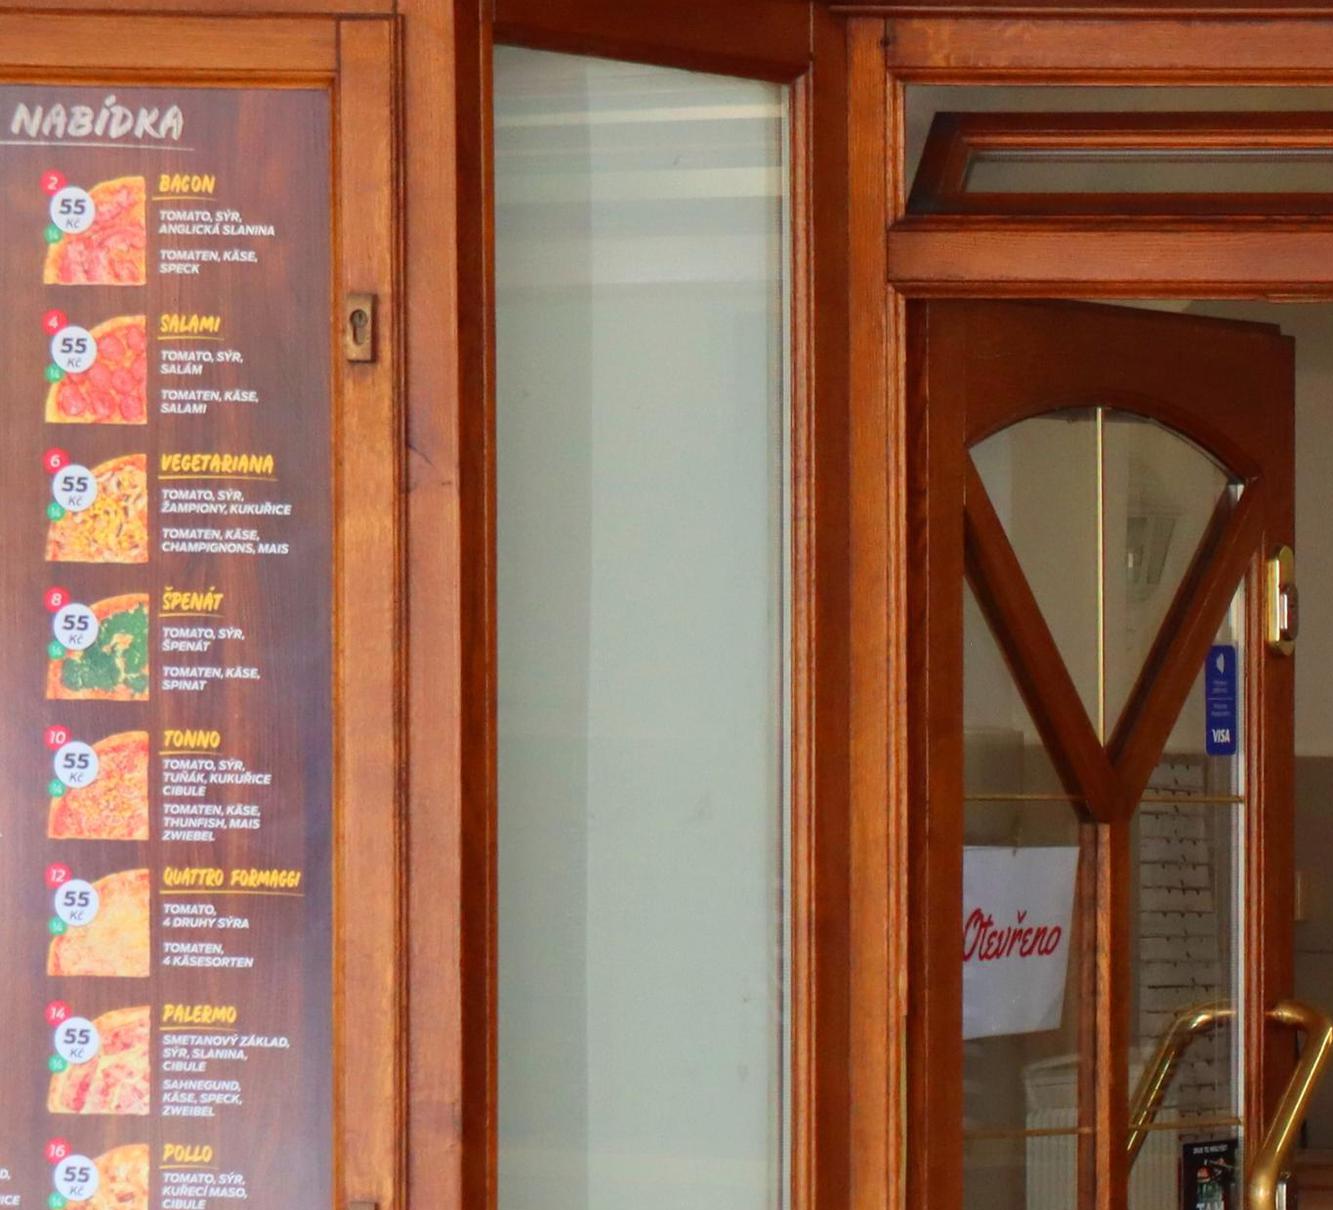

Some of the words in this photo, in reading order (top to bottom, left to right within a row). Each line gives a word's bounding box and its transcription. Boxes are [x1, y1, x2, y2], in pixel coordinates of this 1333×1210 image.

[11, 95, 183, 140] NABÍDKA
[159, 174, 215, 193] BACON
[59, 198, 86, 215] 55
[159, 210, 213, 223] TOMATO,
[215, 208, 242, 223] SÝR,
[159, 222, 220, 235] ANGLICKÁ
[223, 224, 275, 236] SLANINA
[160, 250, 221, 262] TOMATEN,
[224, 249, 258, 263] KÄSE,
[159, 263, 200, 274] SPECK
[160, 315, 220, 333] SALAMI
[60, 338, 88, 353] 55
[161, 351, 213, 363] TOMATO,
[217, 348, 243, 363] SÝR,
[160, 362, 203, 375] SALÁM
[161, 390, 221, 403] TOMATEN,
[225, 389, 258, 403] KÄSE,
[161, 403, 207, 414] SALAMI
[161, 453, 274, 474] VEGETARIANA
[61, 476, 88, 492] 55
[162, 490, 215, 502] TOMATO,
[217, 488, 244, 502] SÝR,
[161, 501, 228, 515] ŽAMPIONY,
[230, 502, 292, 516] KUKUŘICE
[162, 529, 222, 541] TOMATEN,
[225, 528, 259, 541] KÄSE,
[162, 542, 256, 555] CHAMPIGNONS,
[258, 543, 289, 554] MAIS
[162, 586, 224, 611] ŠPENÁT
[62, 615, 89, 631] 55
[163, 628, 215, 640] TOMATO,
[218, 626, 244, 640] SÝR,
[162, 639, 210, 652] ŠPENÁT
[163, 667, 223, 680] TOMATEN,
[226, 666, 260, 680] KÄSE,
[162, 680, 207, 691] SPINAT
[163, 730, 220, 749] TONNO
[1212, 728, 1231, 743] VISA
[63, 753, 90, 769] 55
[163, 760, 216, 772] TOMATO,
[219, 759, 245, 772] SÝR,
[163, 771, 207, 785] TUŇÁK,
[210, 772, 272, 784] KUKUŘICE
[162, 786, 206, 797] CIBULE
[163, 804, 223, 816] TOMATEN,
[226, 803, 261, 816] KÄSE,
[163, 818, 227, 830] THUNFISH,
[229, 818, 260, 829] MAIS
[162, 831, 215, 841] ZWIEBEL
[163, 867, 225, 888] QUATTRO
[231, 868, 301, 888] FORMAGGI
[63, 891, 90, 907] 55
[164, 905, 216, 916] TOMATO,
[163, 918, 171, 928] 4
[173, 918, 216, 928] DRUHY
[217, 915, 249, 929] SÝRA
[963, 908, 1062, 961] Otevřeno
[164, 943, 224, 956] TOMATEN,
[163, 957, 171, 967] 4
[173, 955, 253, 967] KÄSESORTEN
[163, 1005, 236, 1024] PALERMO
[63, 1029, 90, 1045] 55
[163, 1033, 239, 1046] SMETANOVÝ
[240, 1034, 290, 1048] ZÁKLAD,
[163, 1047, 189, 1060] SÝR,
[192, 1049, 248, 1061] SLANINA,
[162, 1061, 206, 1072] CIBULE
[162, 1080, 241, 1092] SAHNEGUND,
[163, 1092, 198, 1105] KÄSE,
[200, 1093, 243, 1106] SPECK,
[162, 1106, 215, 1116] ZWEIBEL
[163, 1144, 212, 1162] POLLO
[63, 1166, 90, 1183] 55
[163, 1173, 216, 1185] TOMATO,
[219, 1171, 245, 1185] SÝR,
[162, 1184, 207, 1198] KUŘECÍ
[209, 1187, 248, 1199] MASO,
[162, 1199, 205, 1209] CIBULE
